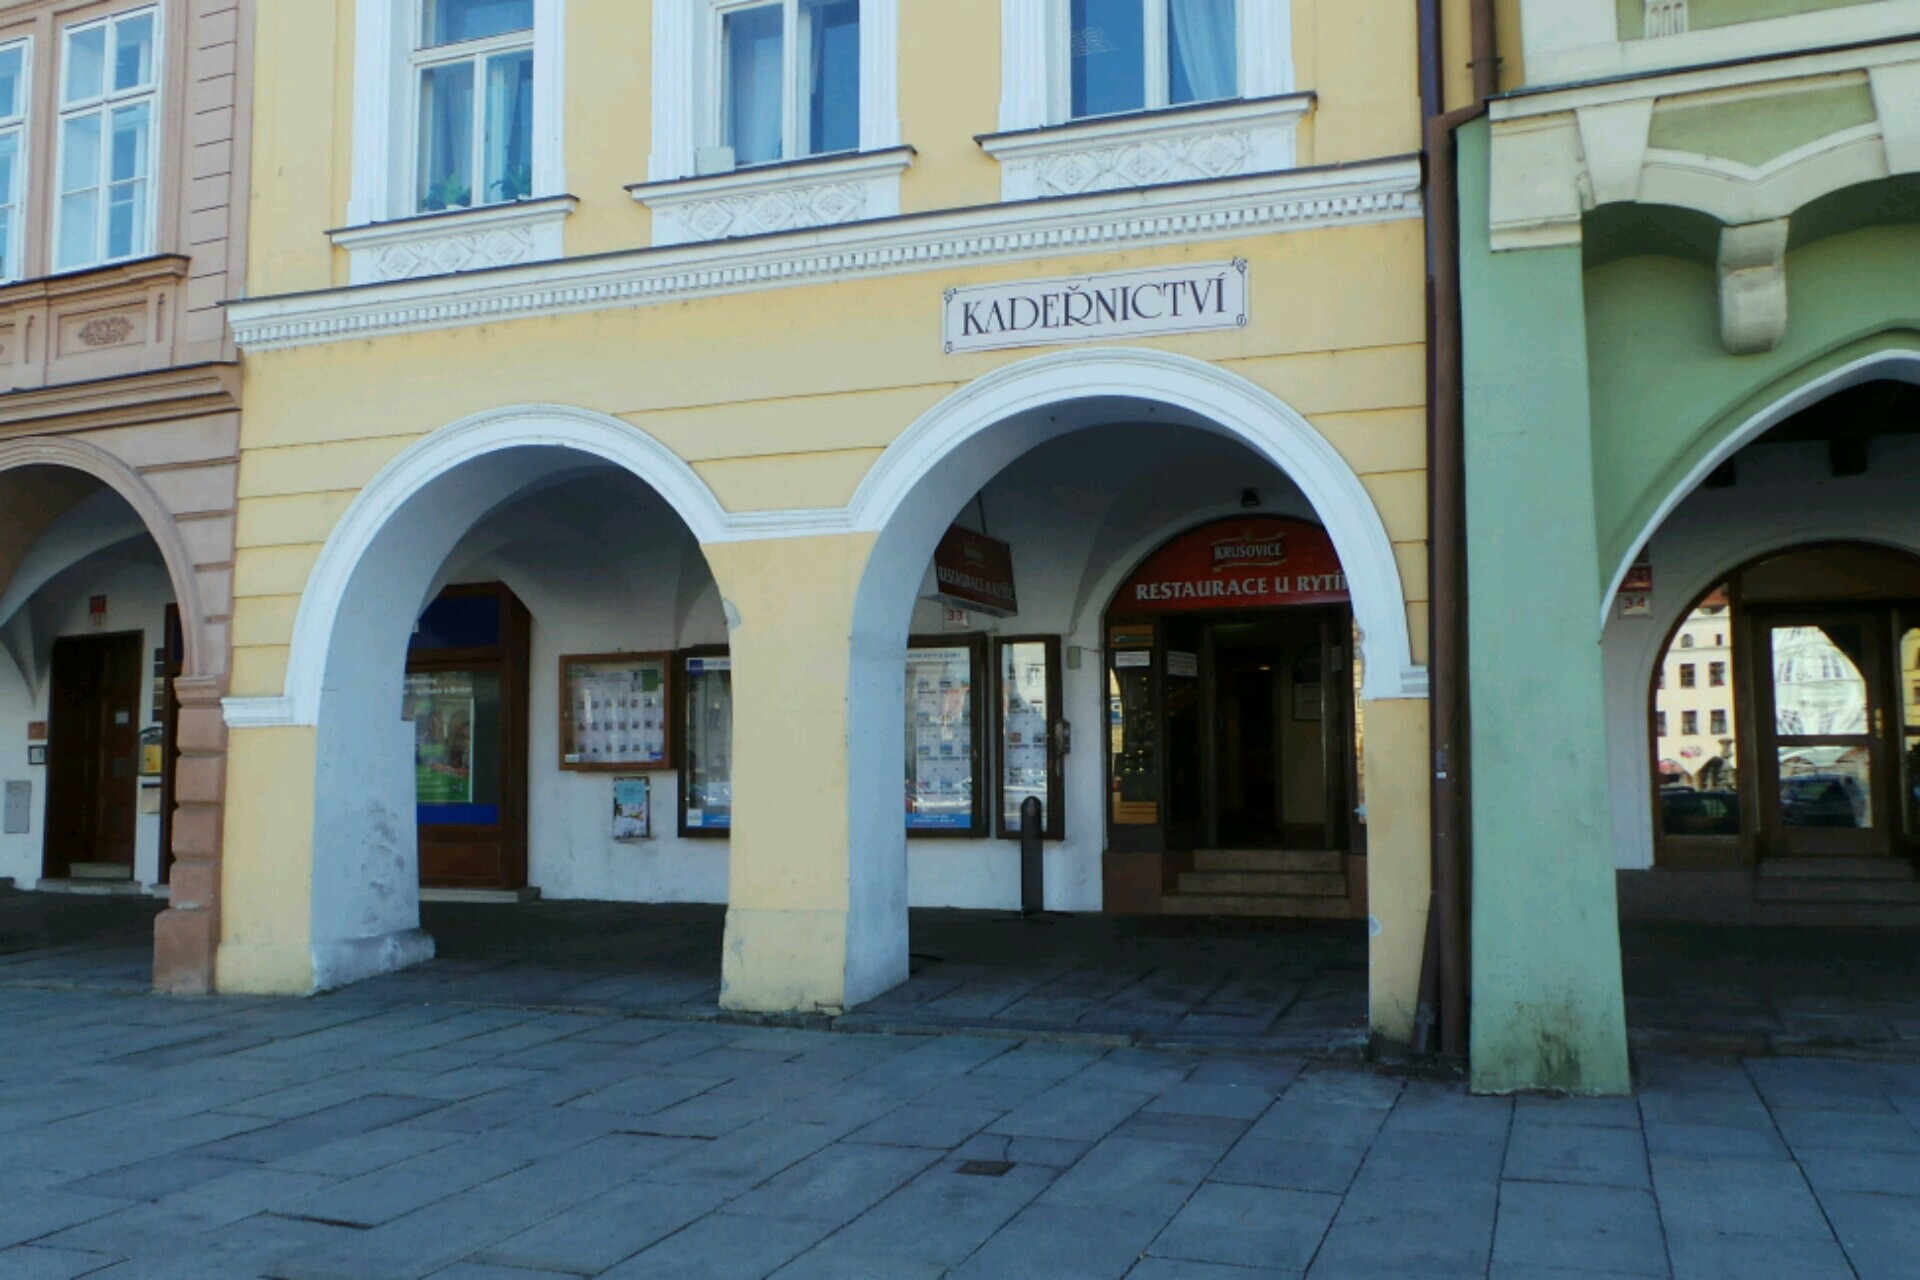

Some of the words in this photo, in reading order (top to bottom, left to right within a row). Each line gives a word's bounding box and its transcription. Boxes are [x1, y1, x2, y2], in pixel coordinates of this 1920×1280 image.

[961, 272, 1226, 337] KADEŘNICTVÍ
[1213, 542, 1283, 561] KRUŠOVICE
[1135, 577, 1269, 600] RESTAURACE
[1274, 577, 1290, 593] U
[1624, 596, 1646, 609] 34
[947, 609, 962, 621] 33
